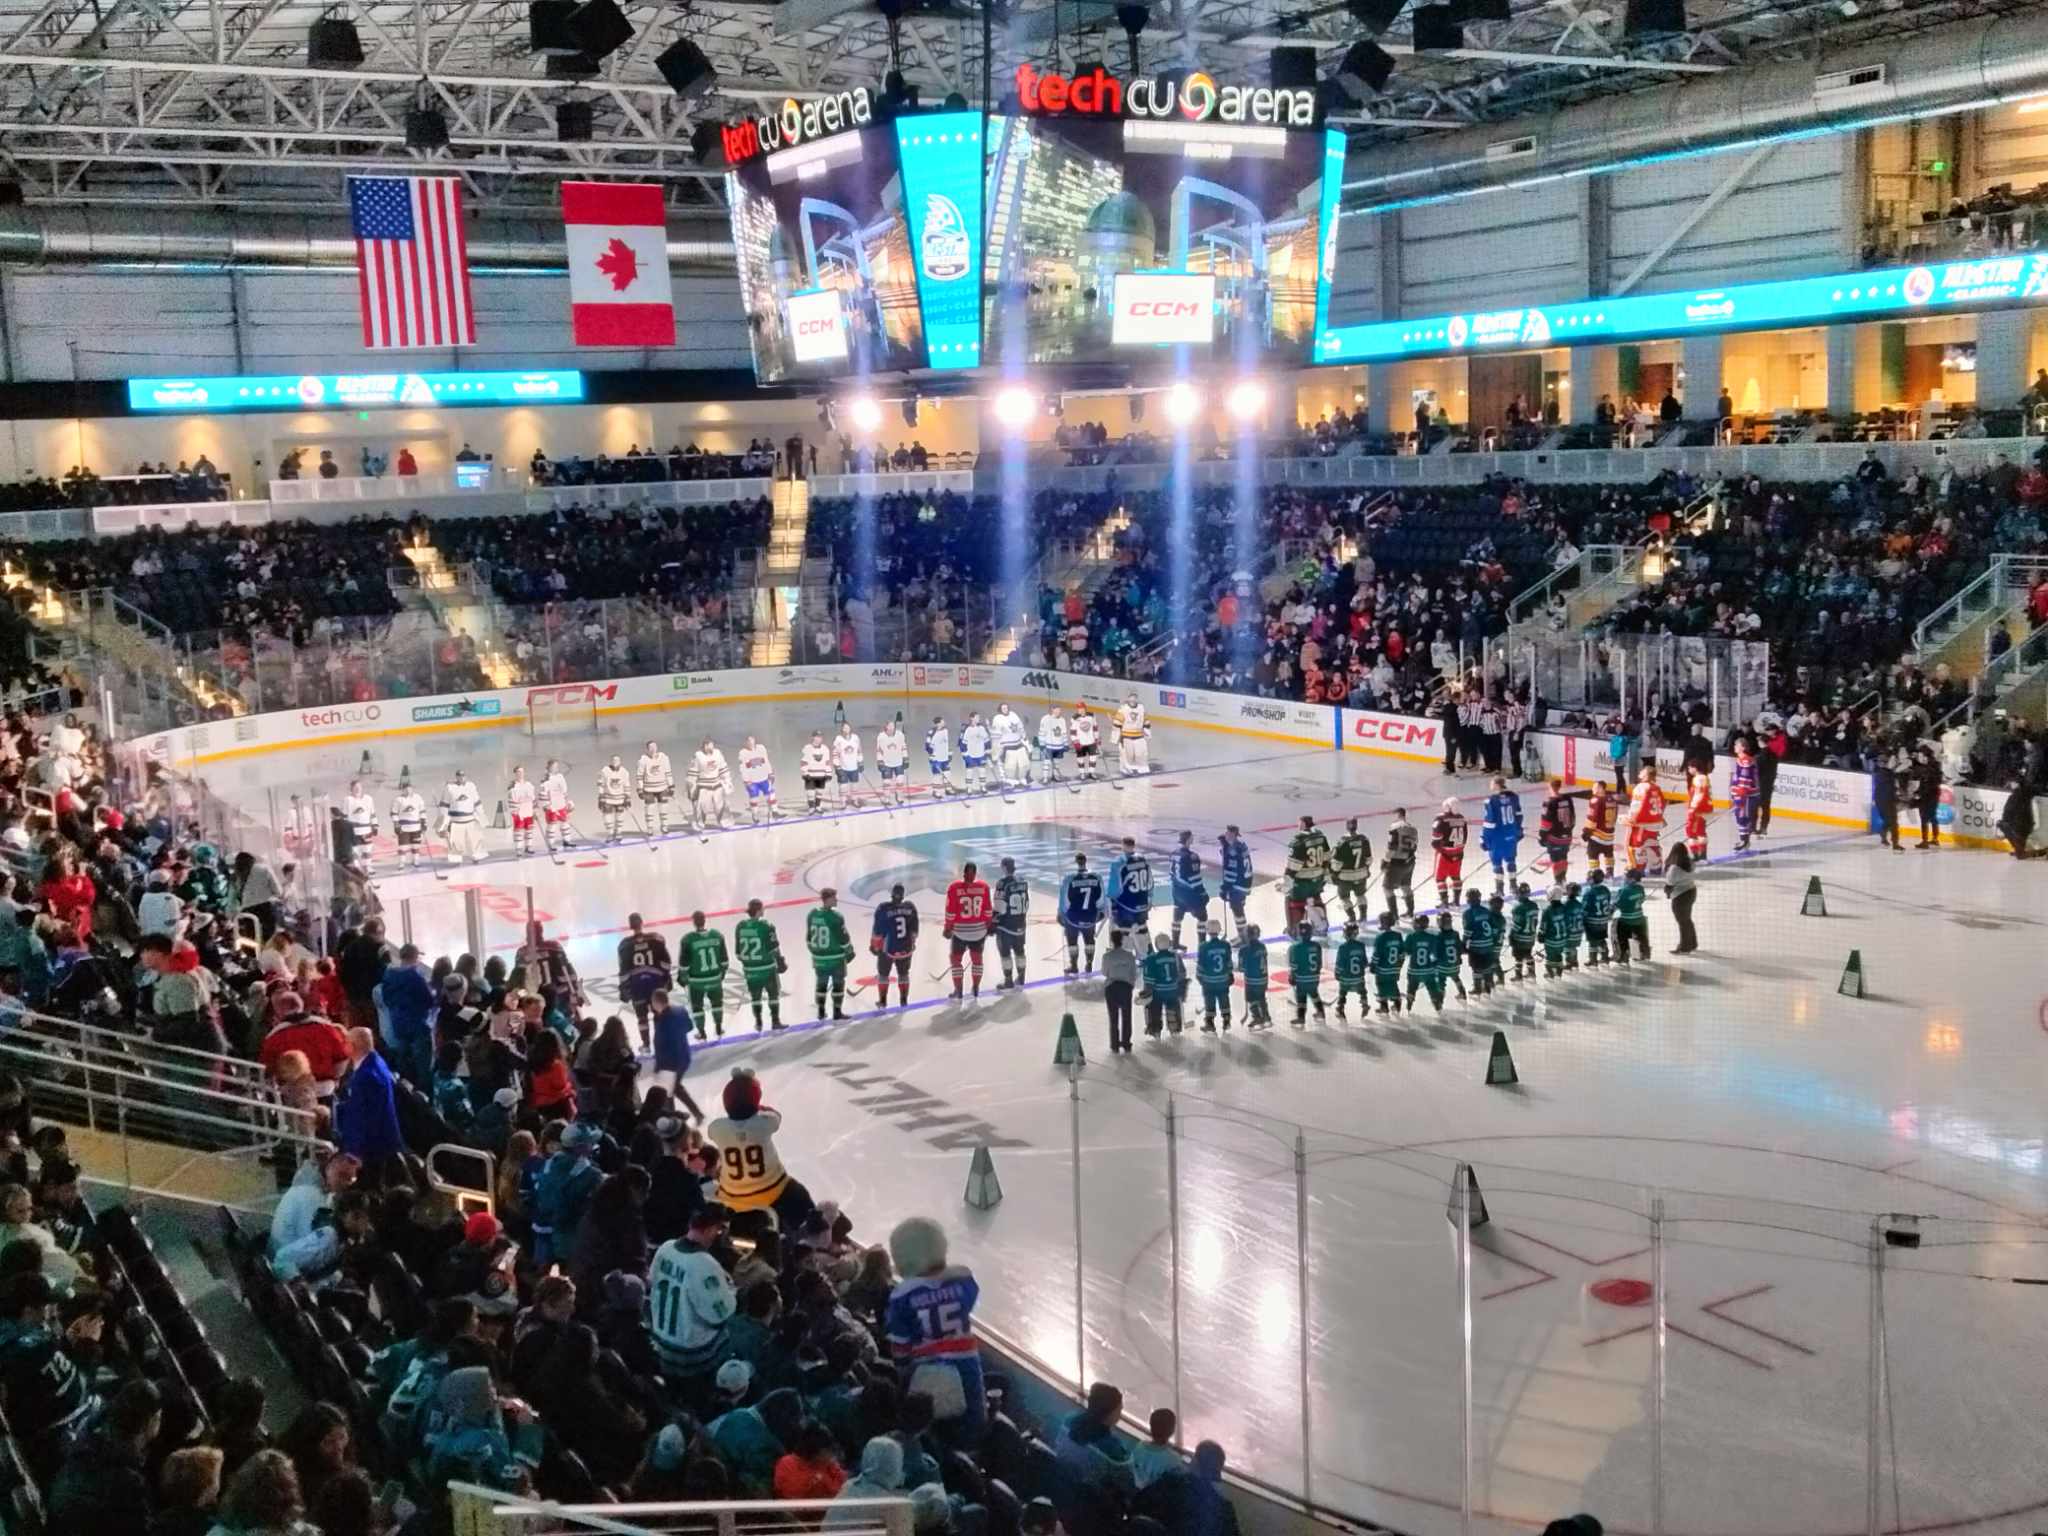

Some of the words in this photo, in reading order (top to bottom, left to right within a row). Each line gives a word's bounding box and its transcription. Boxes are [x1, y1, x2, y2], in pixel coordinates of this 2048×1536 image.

[1015, 63, 1121, 113] tech
[1219, 86, 1314, 125] arena
[720, 118, 760, 164] tech
[802, 87, 872, 137] arena
[1128, 302, 1200, 317] CCM
[799, 319, 834, 336] CCM
[302, 710, 342, 727] tech
[413, 708, 454, 720] SHARKS
[1355, 718, 1437, 747] CCM
[1808, 789, 1849, 804] CARDS
[1500, 806, 1514, 825] 10
[1307, 845, 1323, 867] 30
[1352, 846, 1362, 867] 7
[1127, 866, 1150, 893] 30
[960, 896, 983, 919] 38
[1079, 887, 1092, 911] 7
[810, 925, 830, 949] 28
[895, 916, 906, 939] 3
[1482, 918, 1493, 937] 9
[698, 947, 719, 972] 11
[739, 937, 763, 961] 22
[1388, 944, 1398, 963] 8
[1416, 947, 1427, 966] 8
[1446, 944, 1458, 963] 9
[1212, 954, 1224, 973] 3
[1307, 952, 1317, 971] 5
[1349, 956, 1361, 976] 6
[1162, 964, 1172, 983] 1
[724, 1144, 766, 1181] 99
[657, 1278, 681, 1338] 11
[916, 1301, 962, 1337] 15
